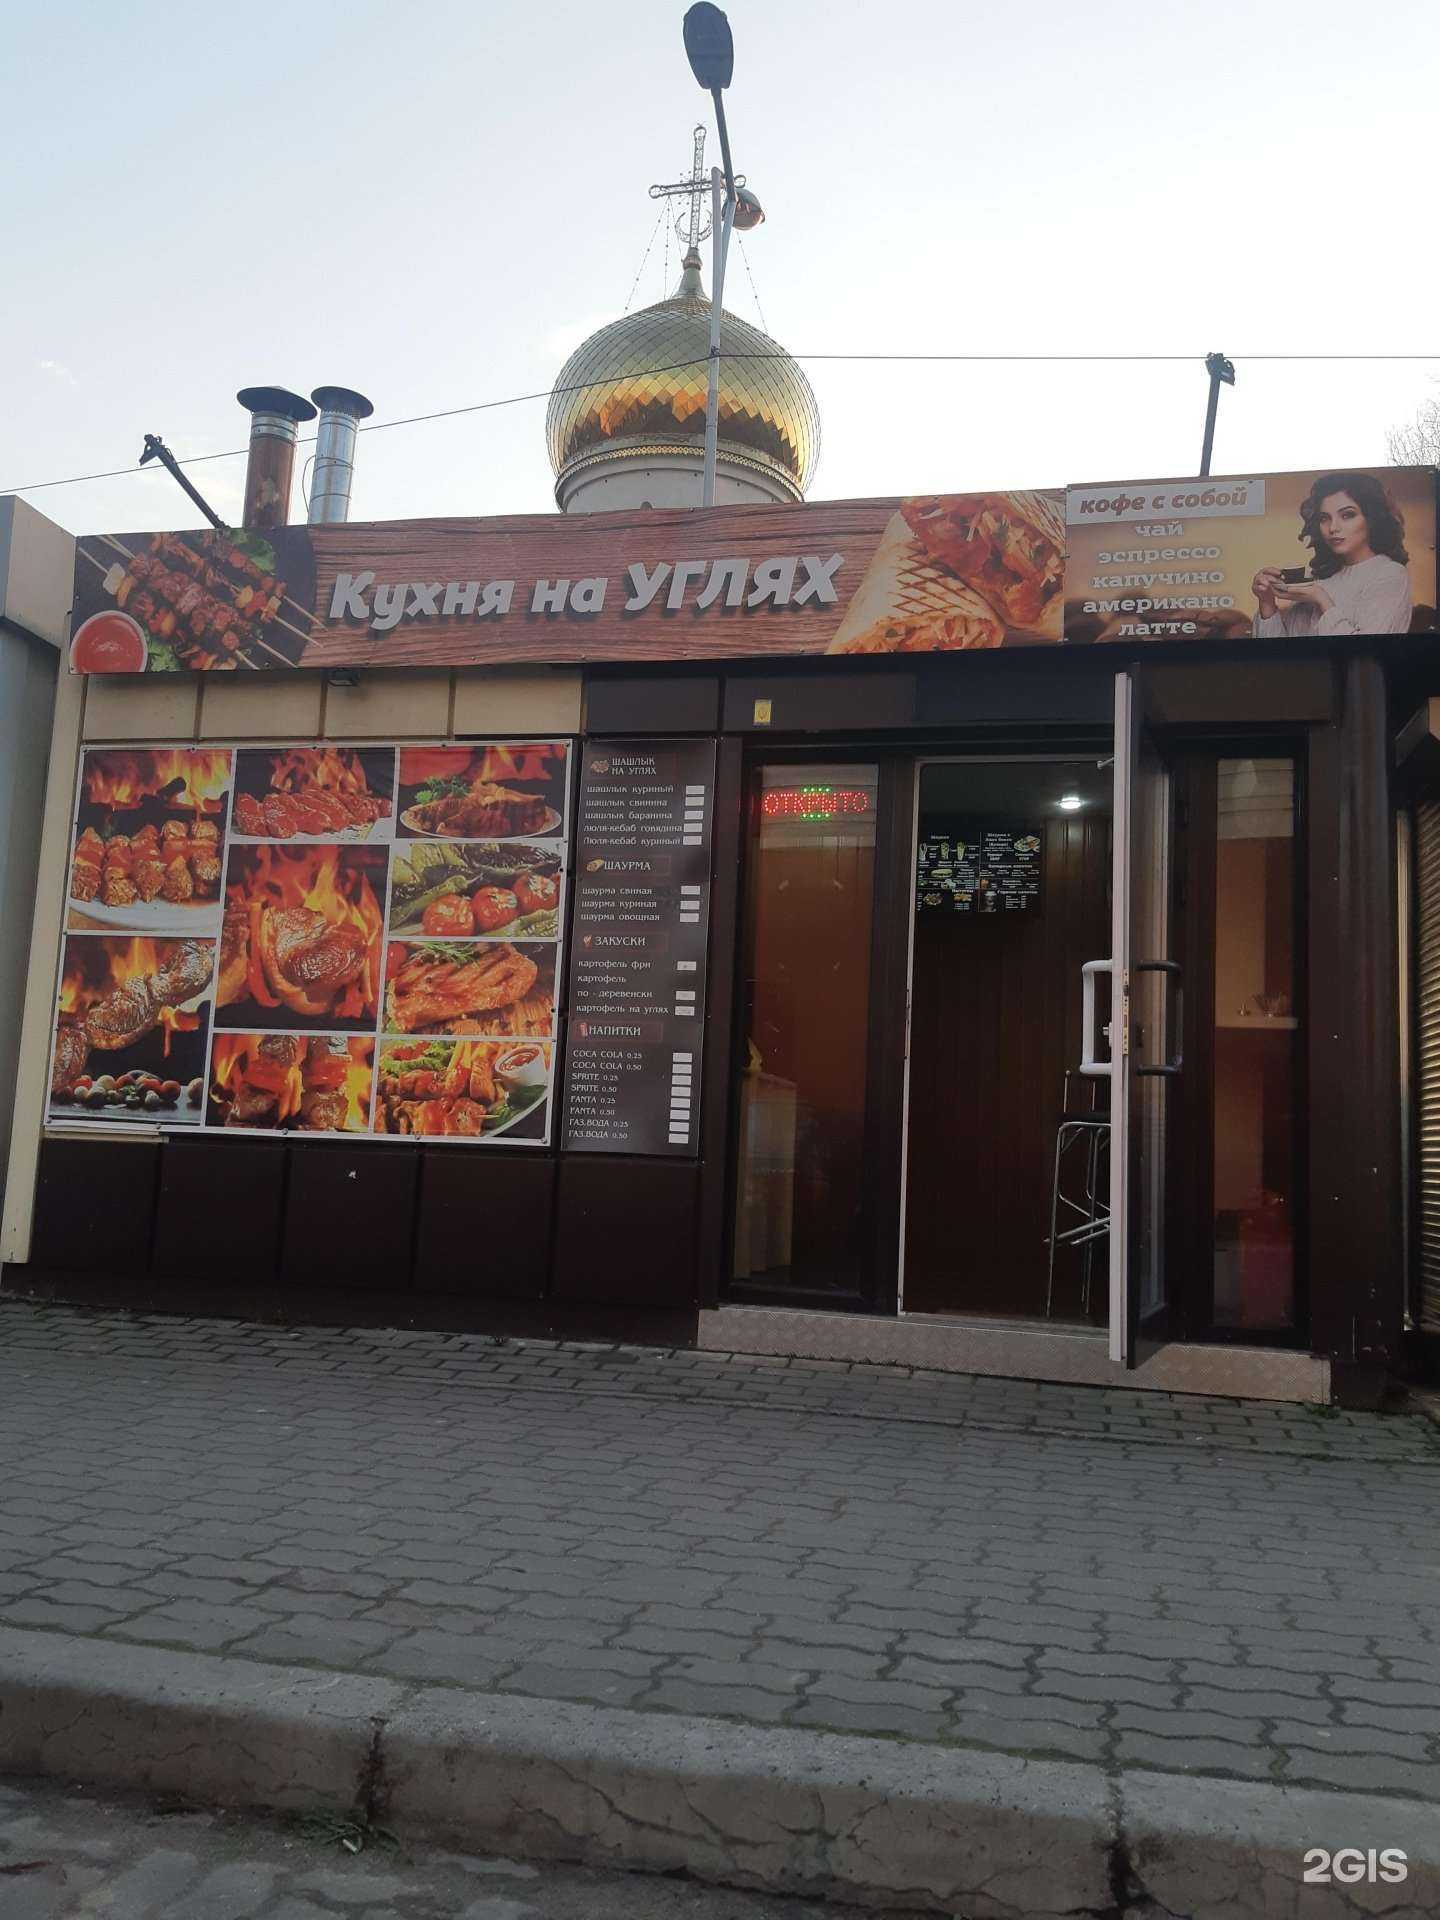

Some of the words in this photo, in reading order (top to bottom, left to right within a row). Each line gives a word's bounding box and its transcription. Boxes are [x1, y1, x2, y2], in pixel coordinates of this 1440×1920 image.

[1080, 493, 1145, 515] кофе
[1151, 495, 1165, 510] с
[1171, 487, 1248, 509] собой
[1135, 520, 1184, 537] чай
[1099, 547, 1221, 566] эспрессо
[1091, 572, 1224, 589] капучино
[328, 571, 515, 631] Кухня
[531, 577, 608, 613] на
[625, 553, 845, 611] УГЛЯХ
[1083, 596, 1234, 614] американо
[1118, 621, 1197, 637] латте
[612, 758, 655, 766] ШАШЛЫК
[612, 767, 624, 775] НА
[628, 767, 656, 775] УГЛЯХ
[632, 785, 673, 795] куриный
[764, 792, 868, 813] ОТКРЫТО
[628, 810, 672, 821] баранина
[641, 837, 681, 847] куриный
[604, 861, 650, 870] ШАУРМА
[582, 888, 616, 896] шаурма
[582, 901, 615, 910] шаурма
[619, 901, 657, 909] куриная
[581, 914, 615, 923] шаурма
[594, 936, 646, 946] ЗАКУСКИ
[578, 960, 627, 970] картофель
[631, 960, 651, 970] фри
[577, 975, 627, 984] картофель
[576, 1004, 625, 1014] картофель
[644, 1006, 669, 1014] углях
[589, 1026, 641, 1036] НАПИТКИ
